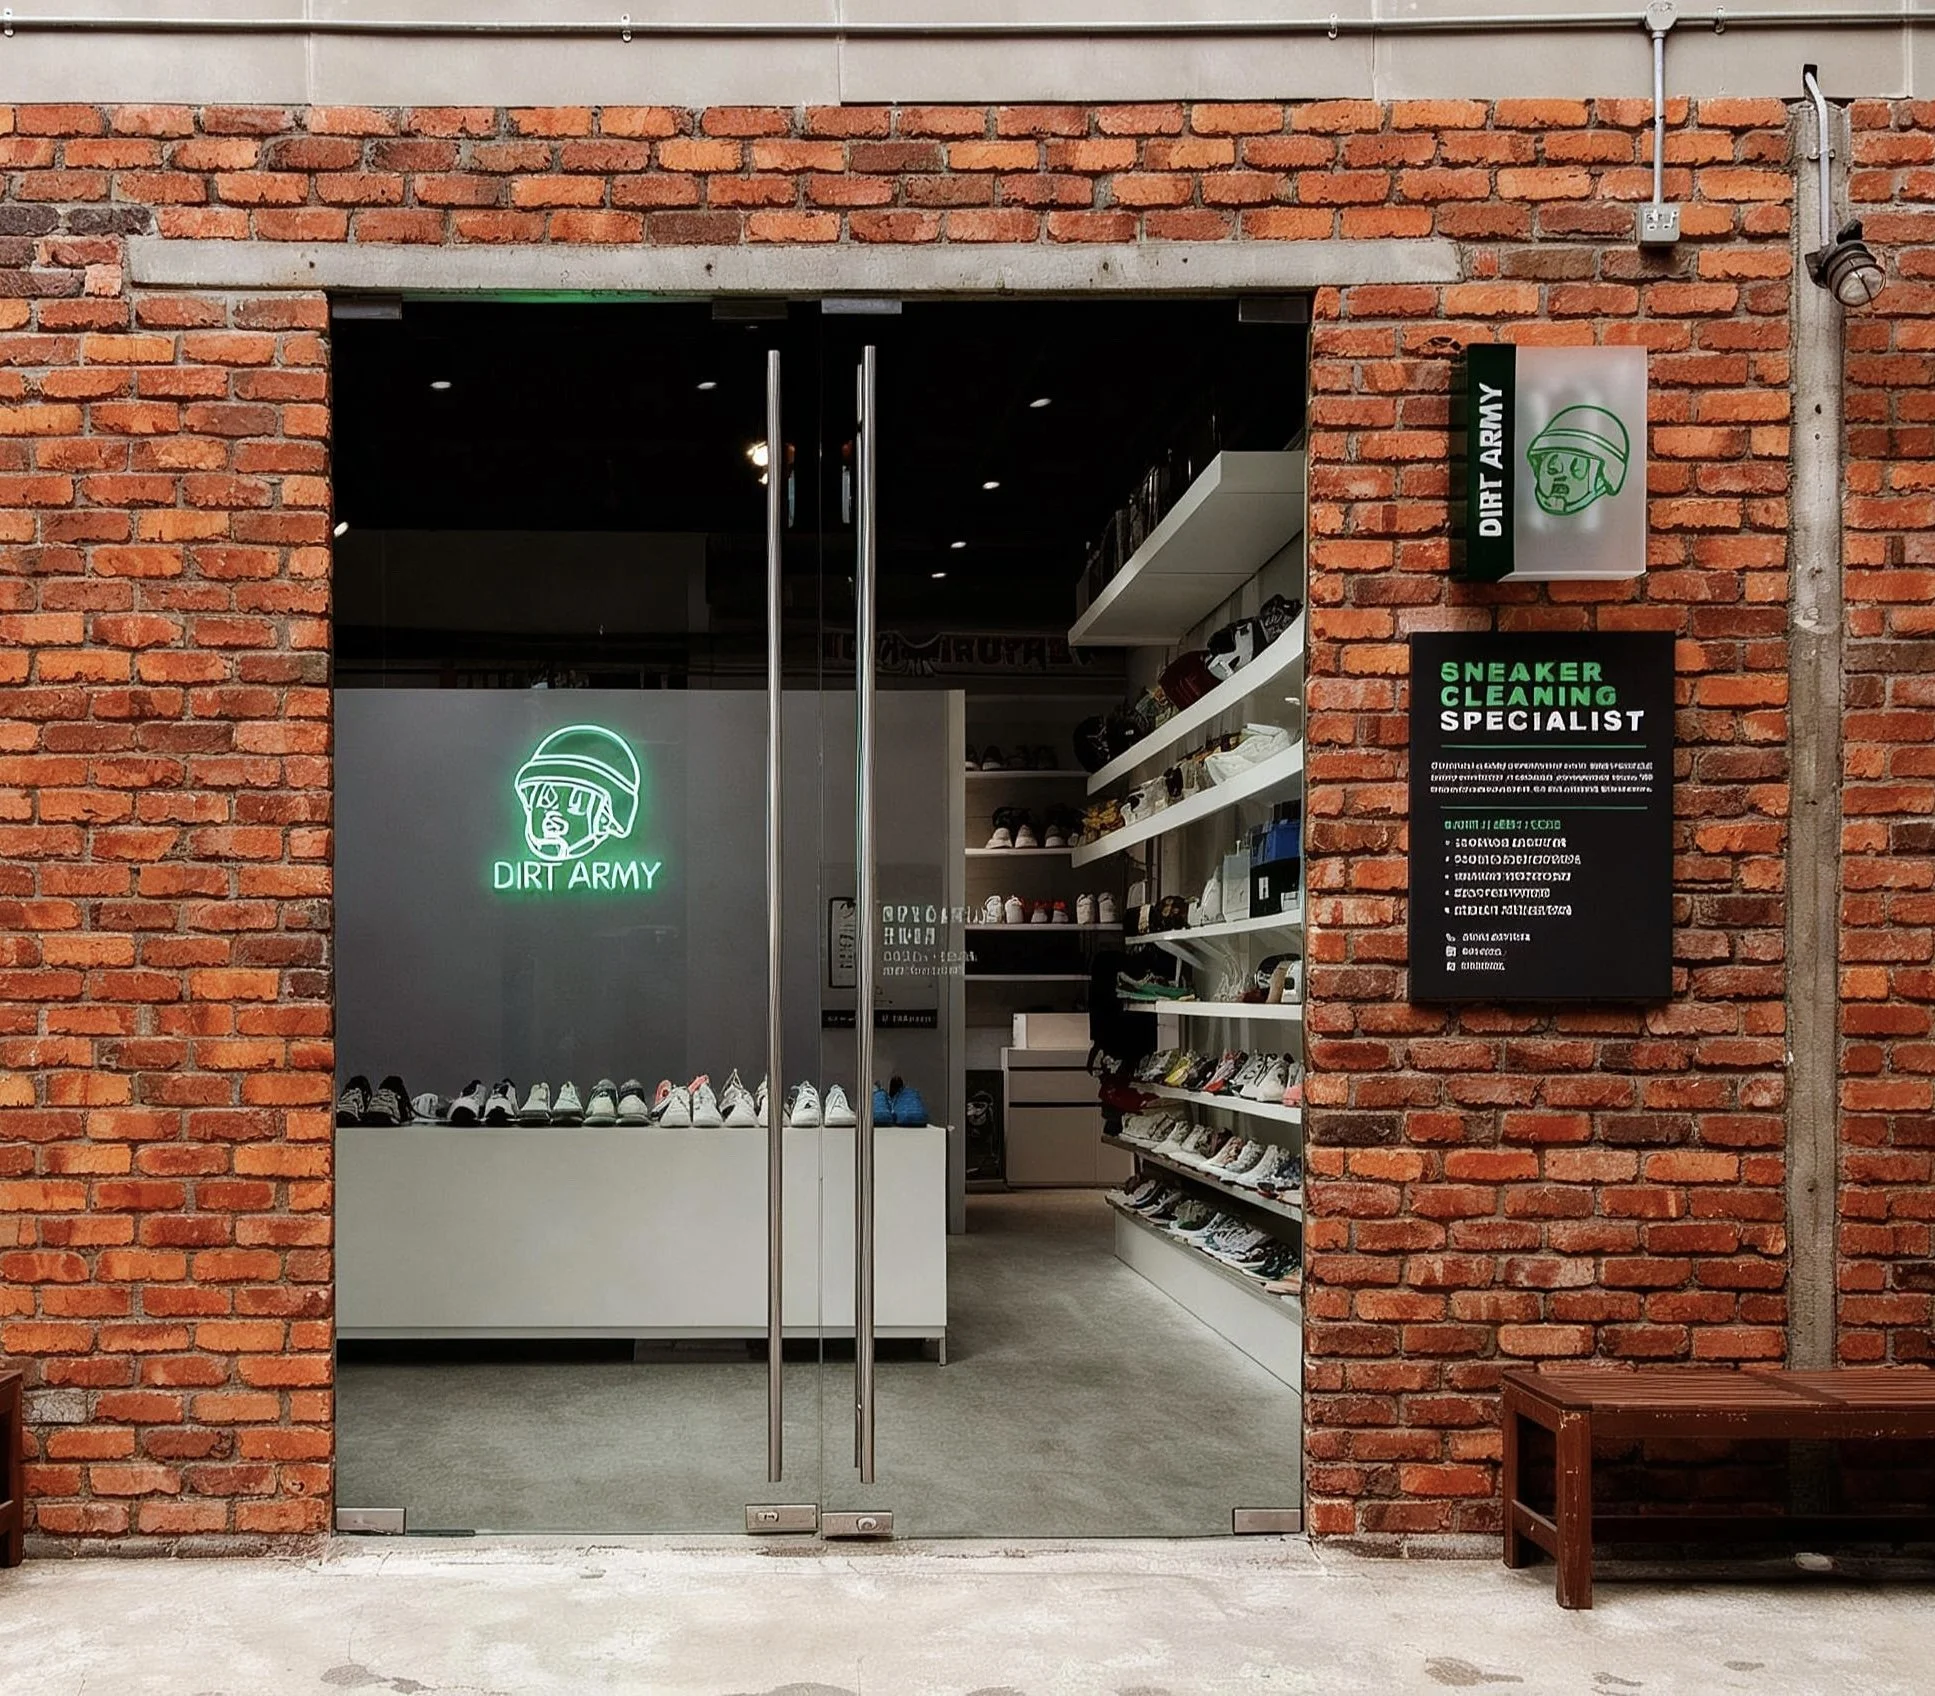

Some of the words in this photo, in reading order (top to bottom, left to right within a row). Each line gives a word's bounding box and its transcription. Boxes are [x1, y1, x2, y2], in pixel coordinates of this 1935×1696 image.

[1479, 382, 1503, 469] ARMY
[1479, 473, 1503, 537] DIRT
[1440, 661, 1603, 683] SNEAKER
[1440, 685, 1617, 707] CLEANING
[1440, 710, 1645, 732] SPECIALIST
[493, 861, 563, 890] DIRT
[567, 860, 662, 890] ARMY
